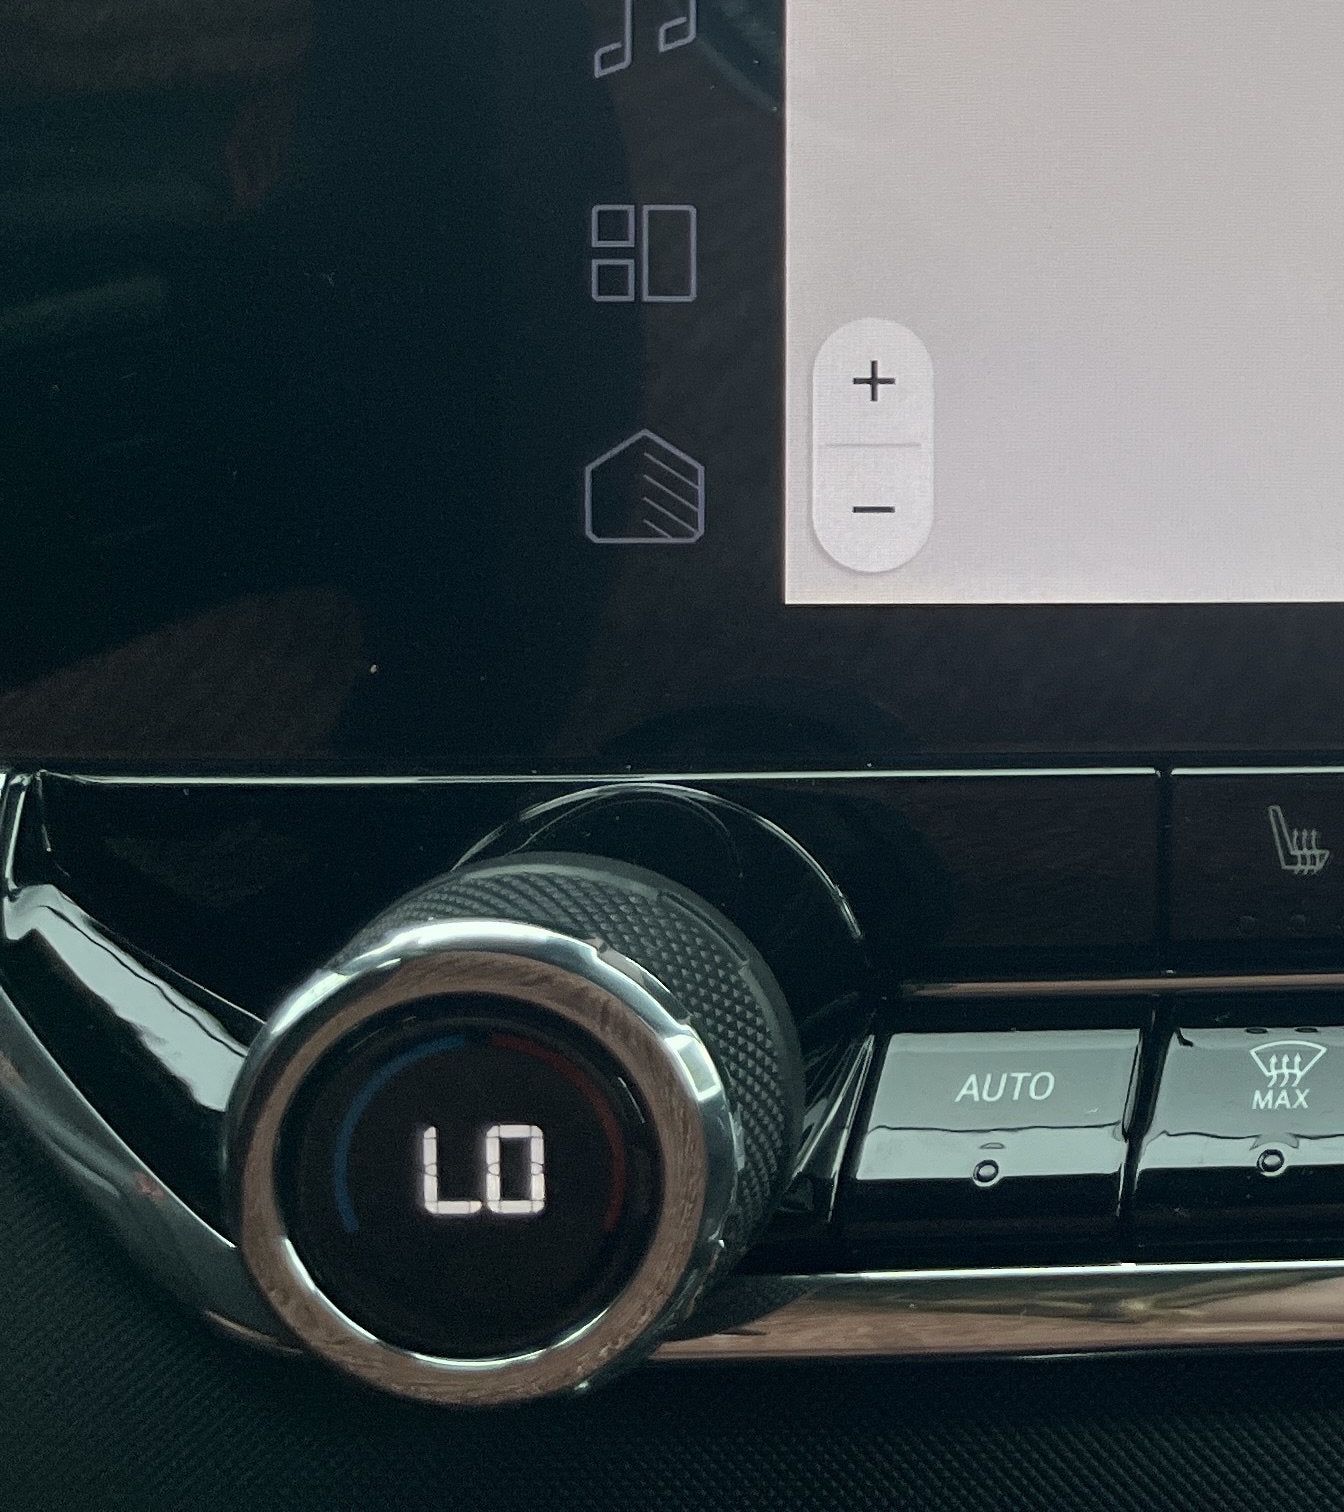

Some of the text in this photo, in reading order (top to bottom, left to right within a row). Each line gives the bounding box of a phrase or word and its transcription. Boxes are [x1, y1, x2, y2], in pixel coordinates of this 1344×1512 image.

[955, 1071, 1056, 1103] AUTO
[1252, 1090, 1310, 1110] MAX
[421, 1123, 546, 1216] LO
